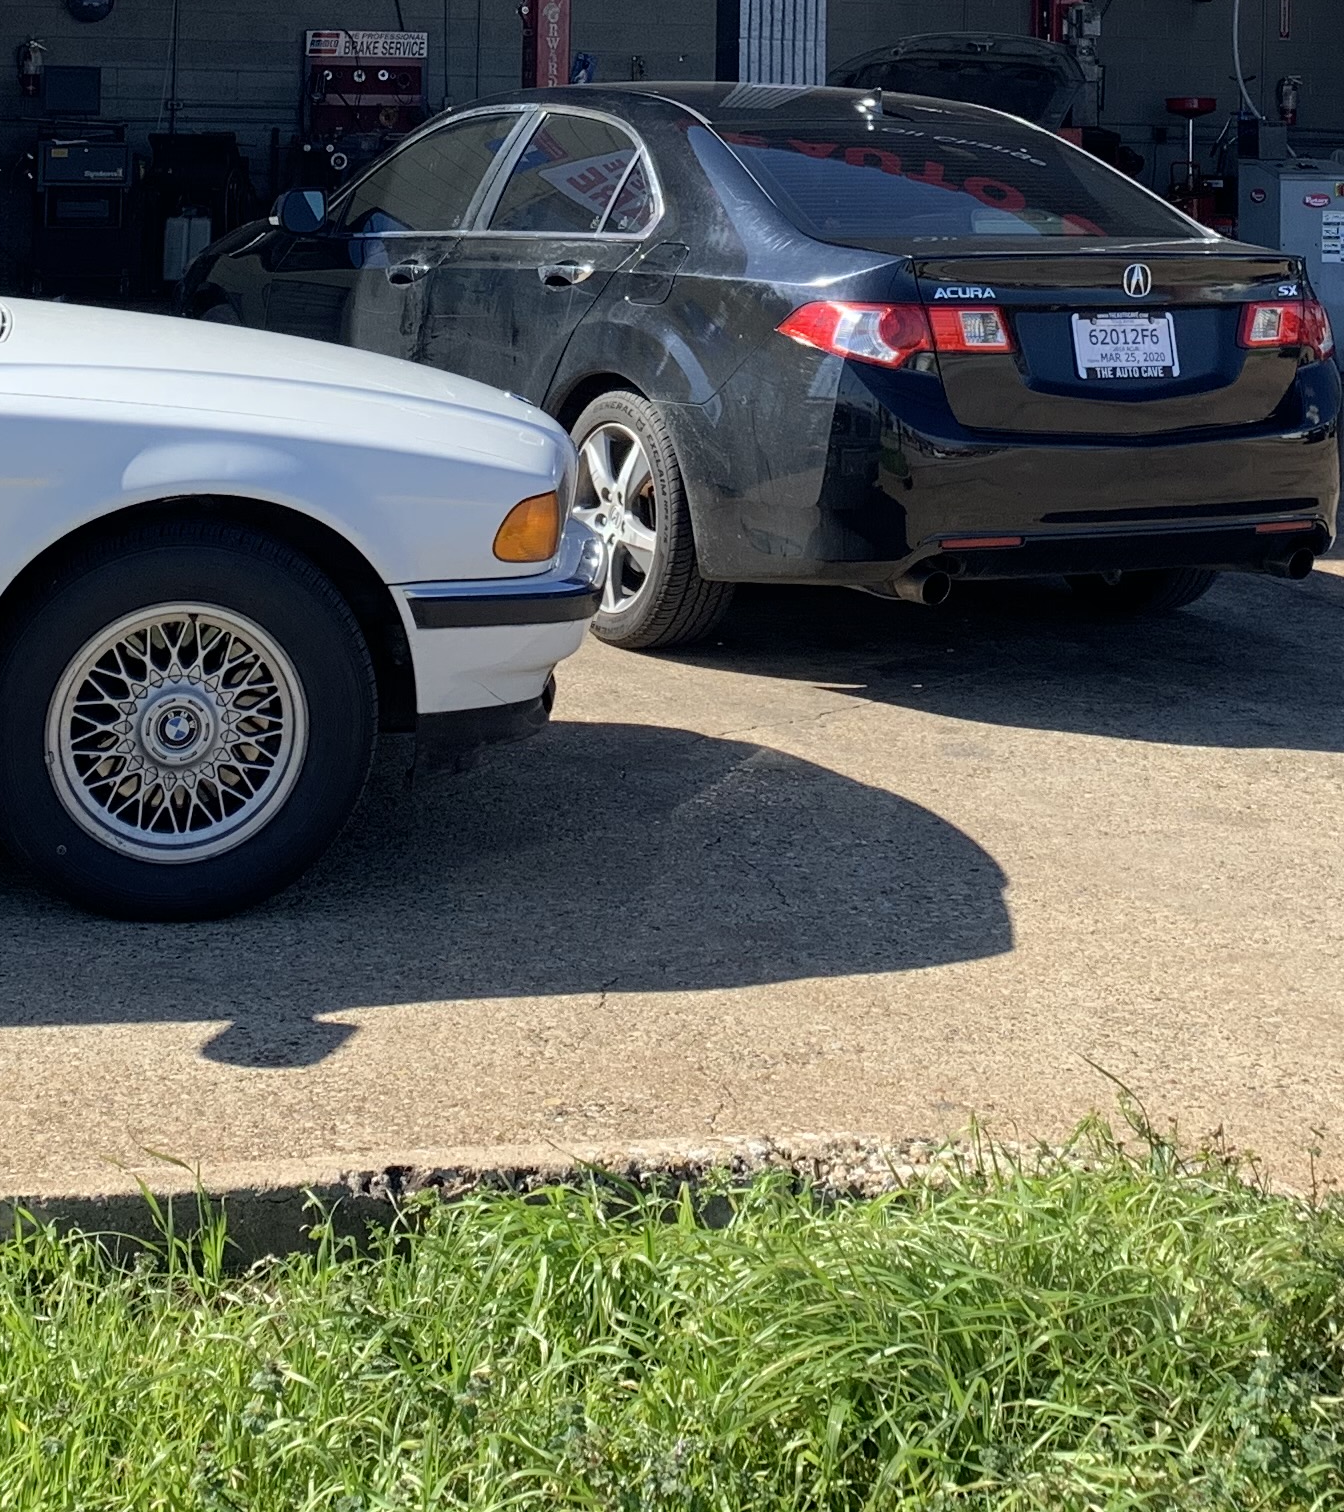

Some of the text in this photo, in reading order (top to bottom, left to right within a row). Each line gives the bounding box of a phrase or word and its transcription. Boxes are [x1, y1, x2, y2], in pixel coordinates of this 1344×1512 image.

[344, 40, 425, 56] BRAKE SERVICE
[934, 287, 996, 299] ACURA
[1089, 329, 1159, 345] 62012F6
[1100, 353, 1122, 362] MAR
[1125, 353, 1140, 364] 25,
[1143, 352, 1166, 362] 2020
[1095, 367, 1164, 378] THE AUTO CAVE
[593, 401, 634, 418] GENERAL
